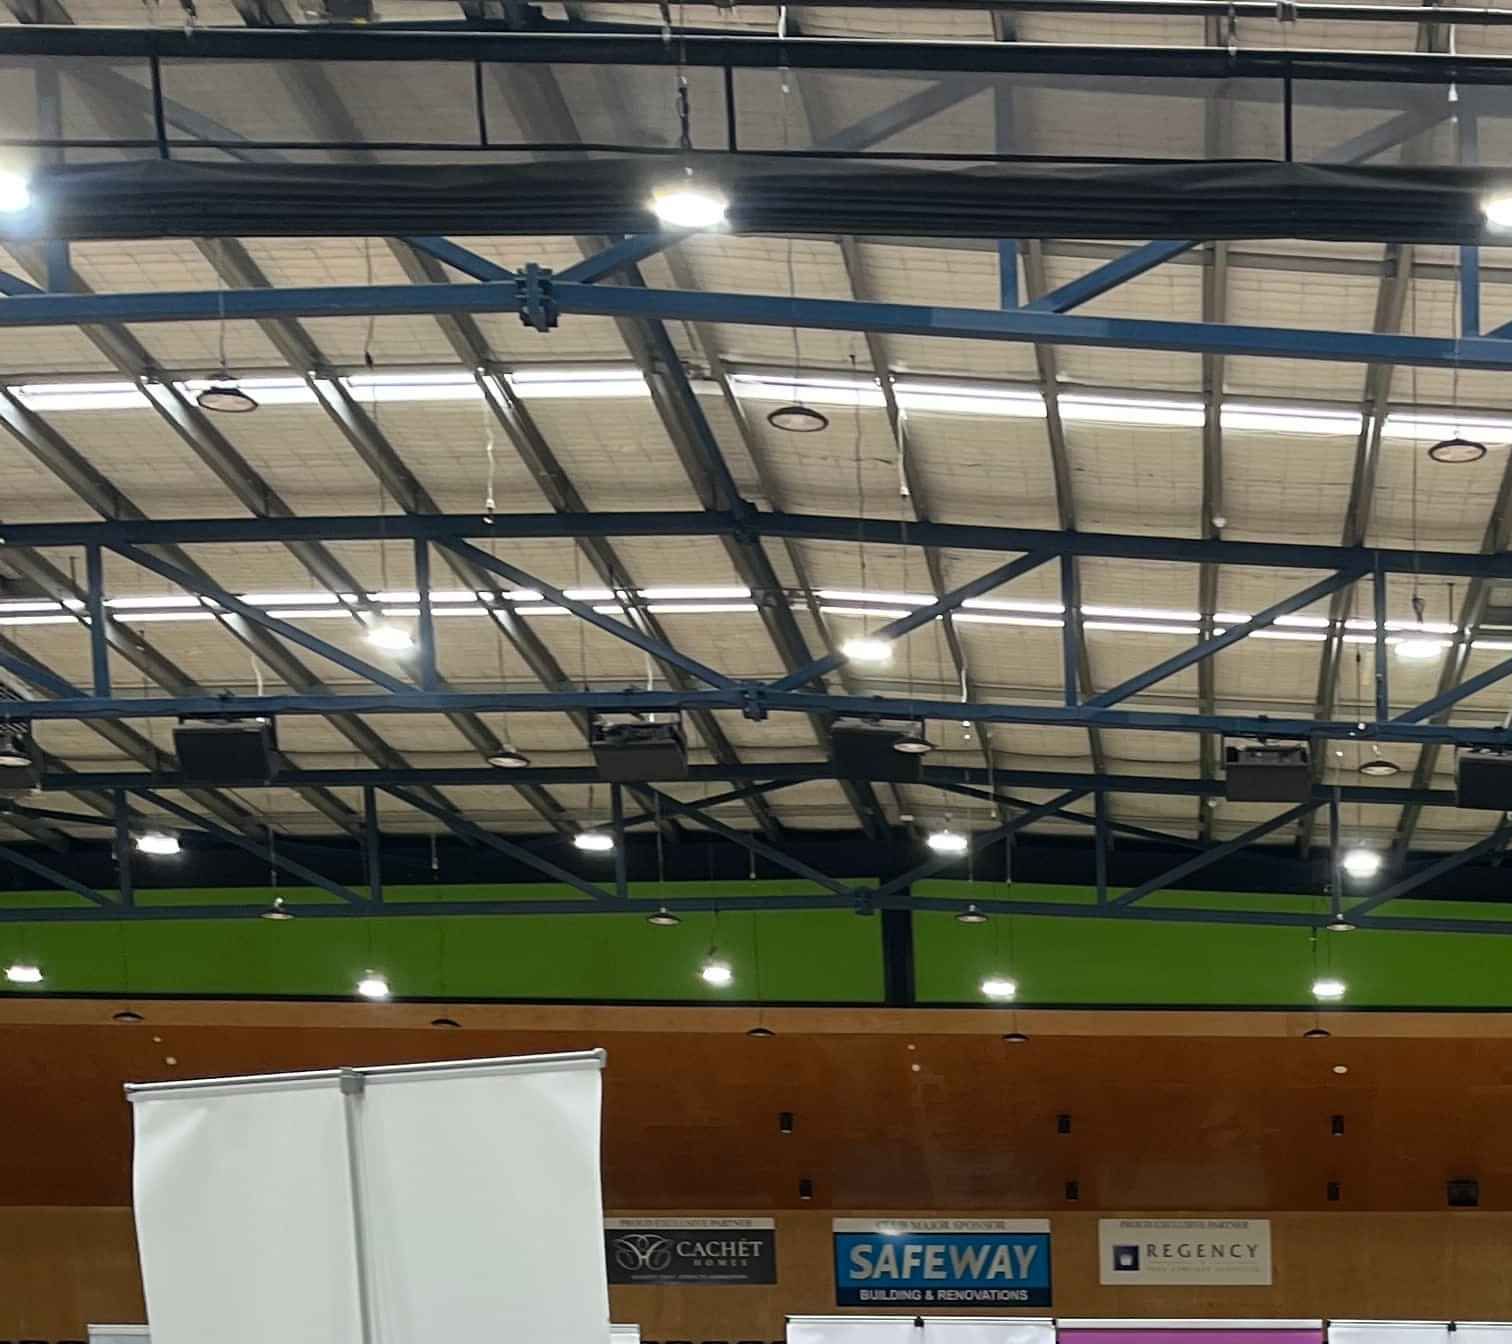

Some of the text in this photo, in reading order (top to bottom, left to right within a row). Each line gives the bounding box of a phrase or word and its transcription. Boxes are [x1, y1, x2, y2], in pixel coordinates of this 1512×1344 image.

[1146, 1243, 1260, 1258] REGENCY
[849, 1244, 1038, 1280] SAFEWAY
[860, 1289, 1029, 1300] BUILDING & RENOVATIONS
